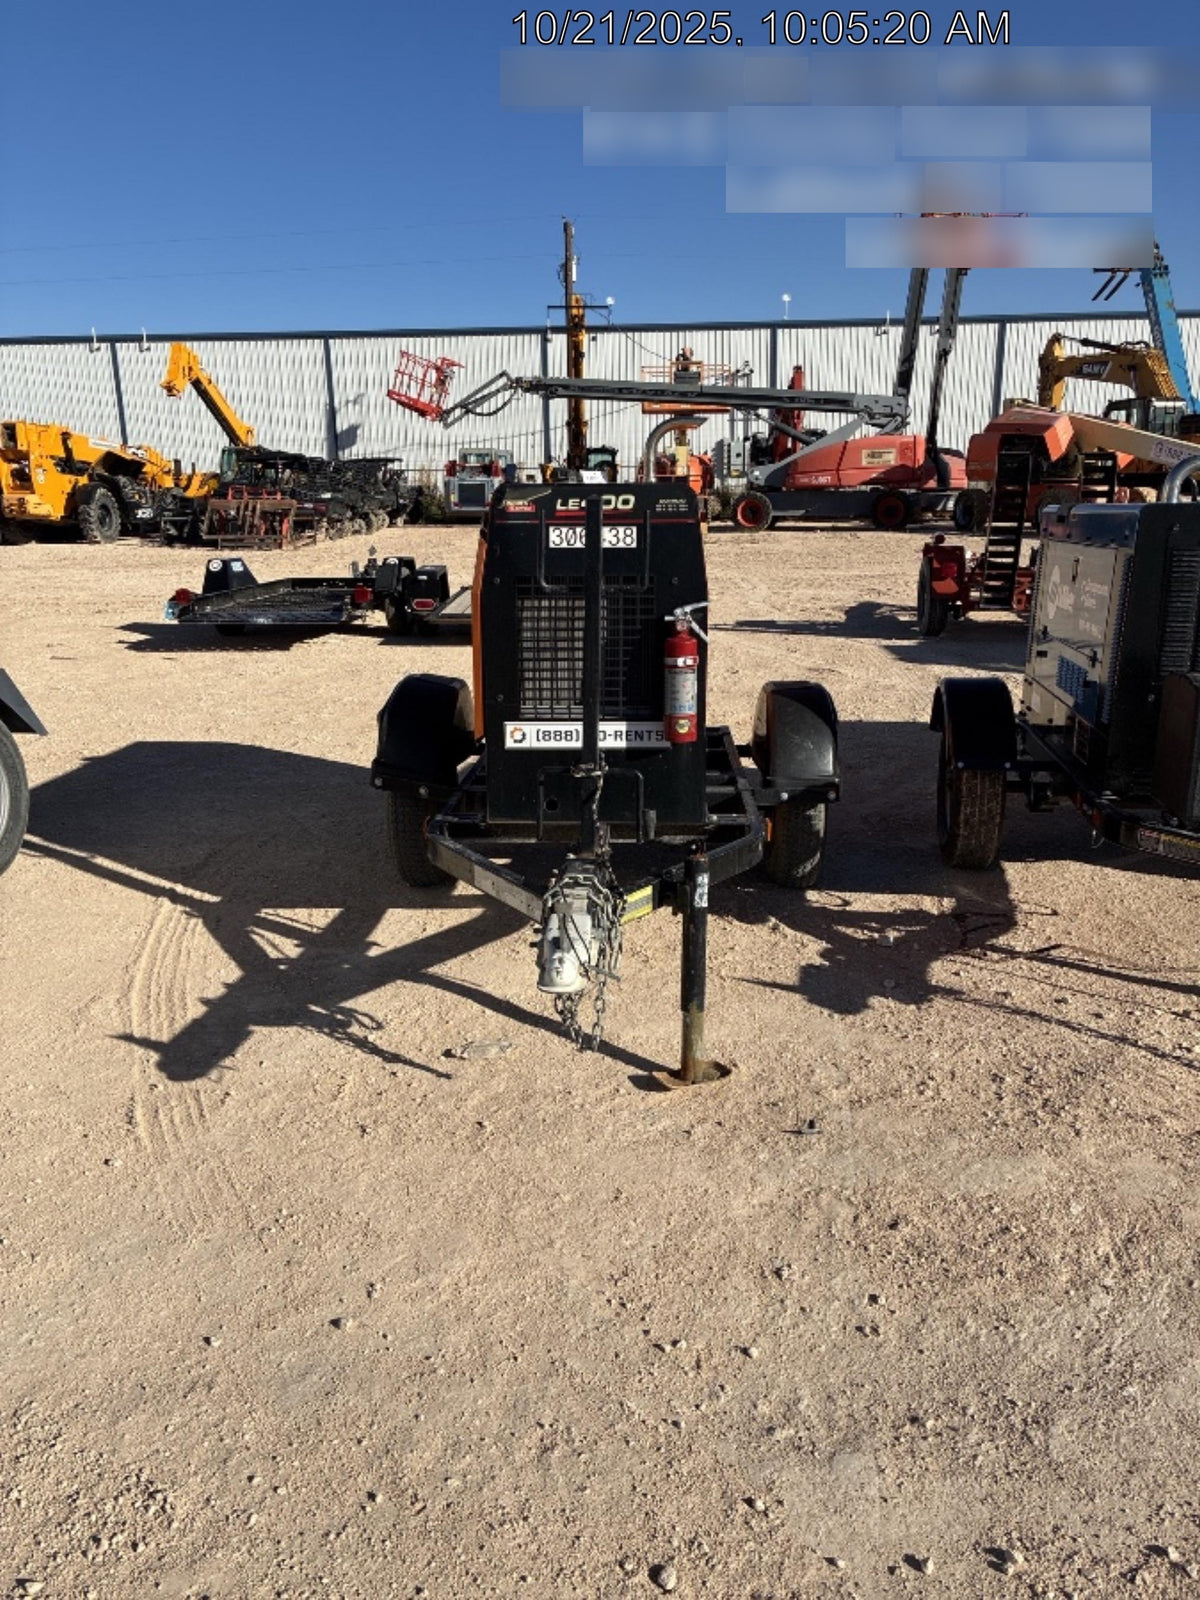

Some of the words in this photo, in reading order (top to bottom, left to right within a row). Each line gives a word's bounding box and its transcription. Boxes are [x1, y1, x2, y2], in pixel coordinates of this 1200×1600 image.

[555, 494, 636, 511] LE00
[536, 728, 580, 742] (888)
[598, 729, 664, 742] 0-RENTS
